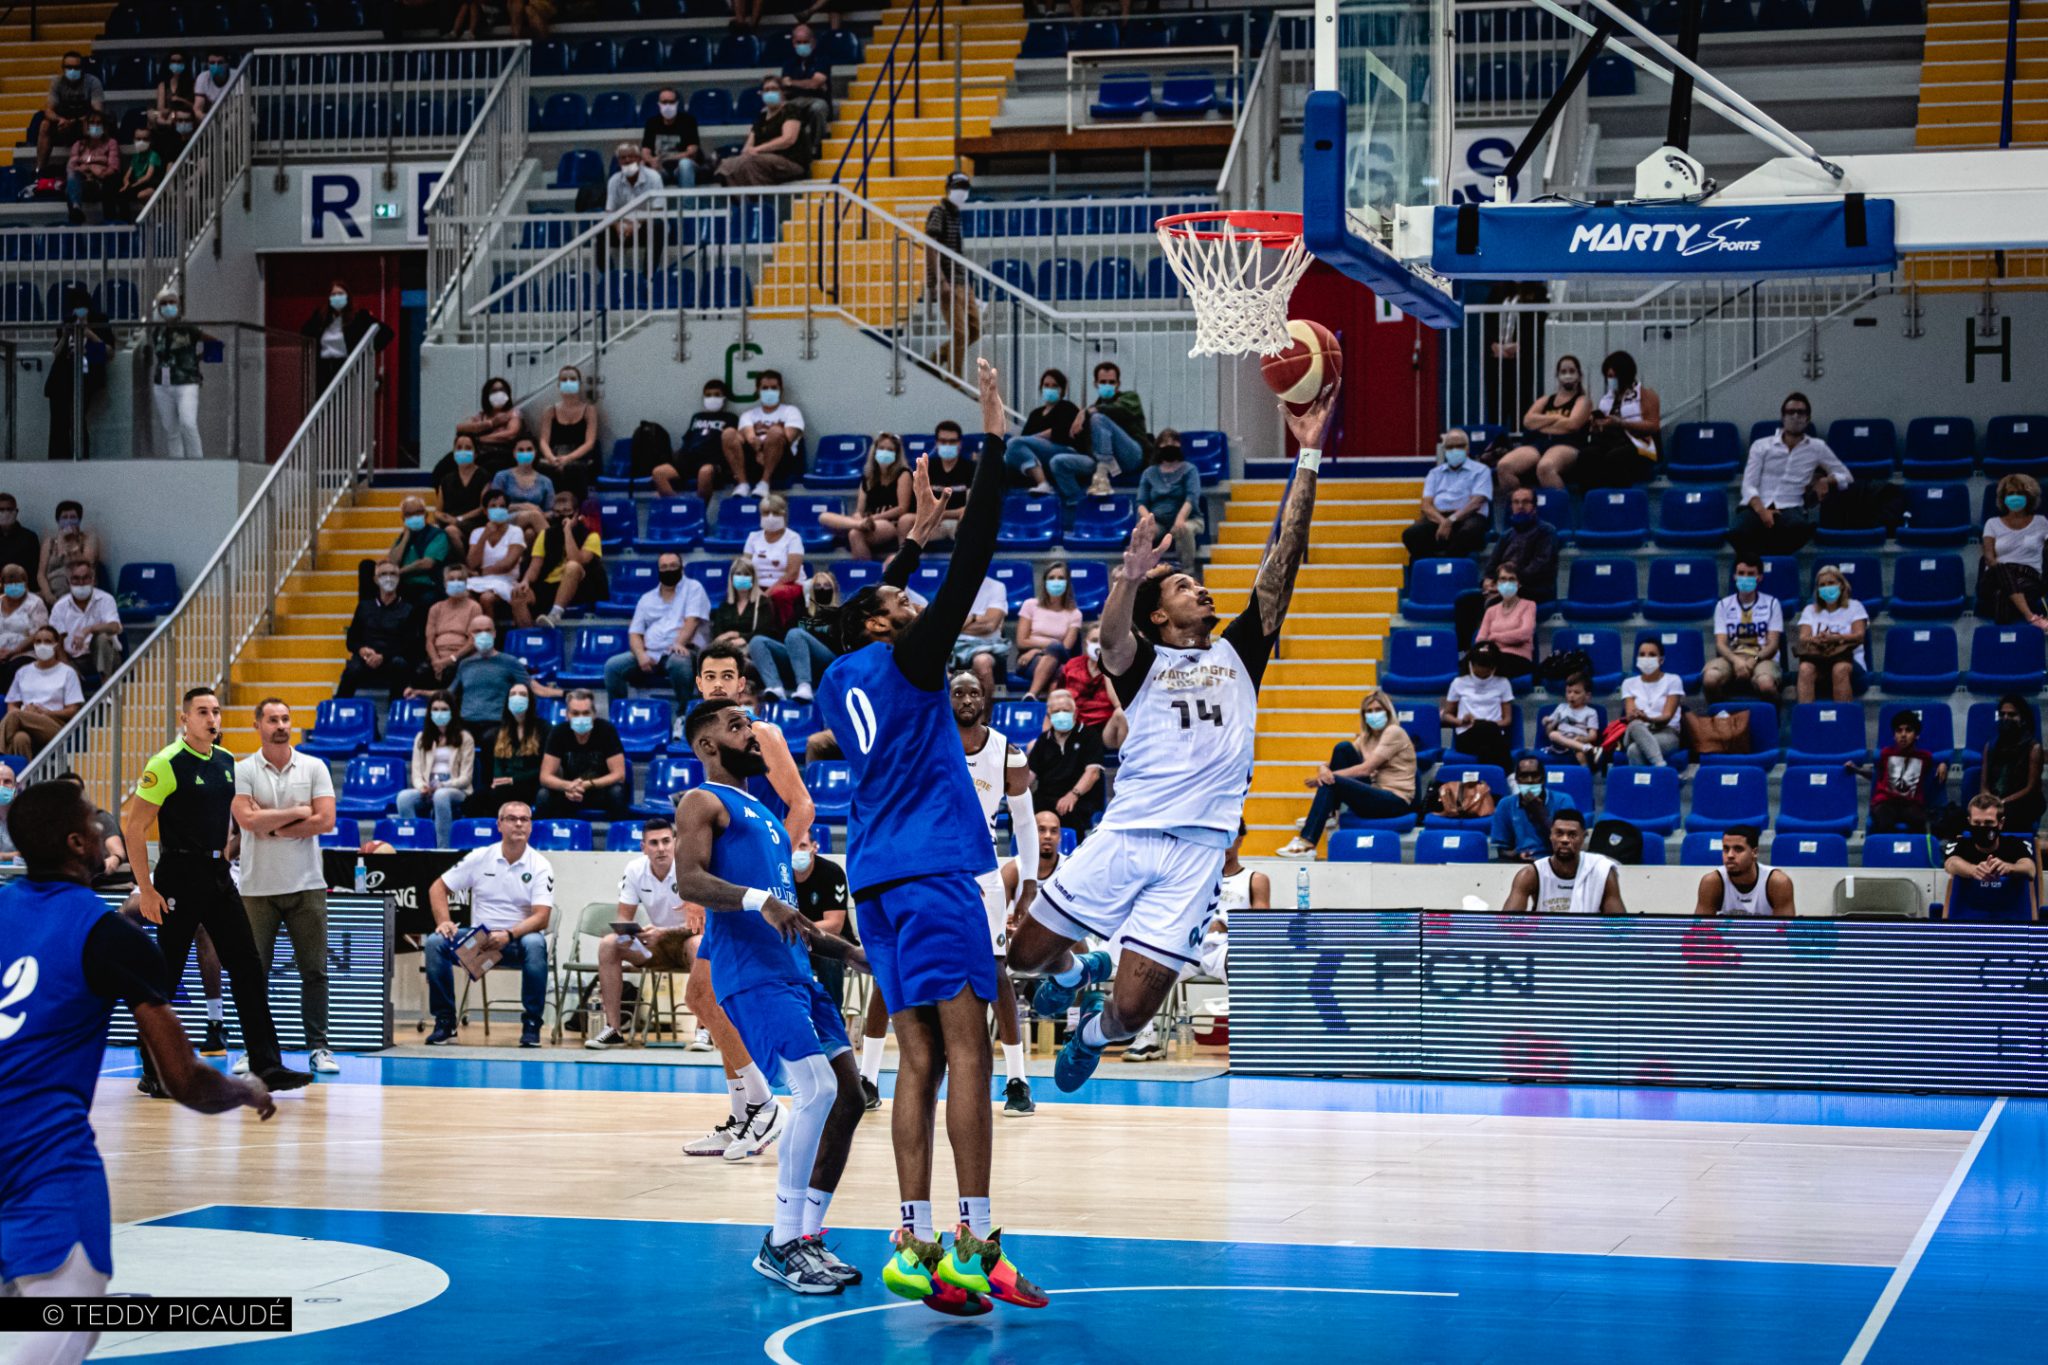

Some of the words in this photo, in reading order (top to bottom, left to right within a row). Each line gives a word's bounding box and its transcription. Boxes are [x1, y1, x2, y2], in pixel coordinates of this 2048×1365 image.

[311, 173, 364, 239] R
[1568, 223, 1701, 253] MARTY
[724, 342, 764, 403] G
[1965, 316, 2011, 384] H
[846, 687, 877, 755] 0
[1170, 698, 1224, 730] 14
[765, 820, 780, 845] 5
